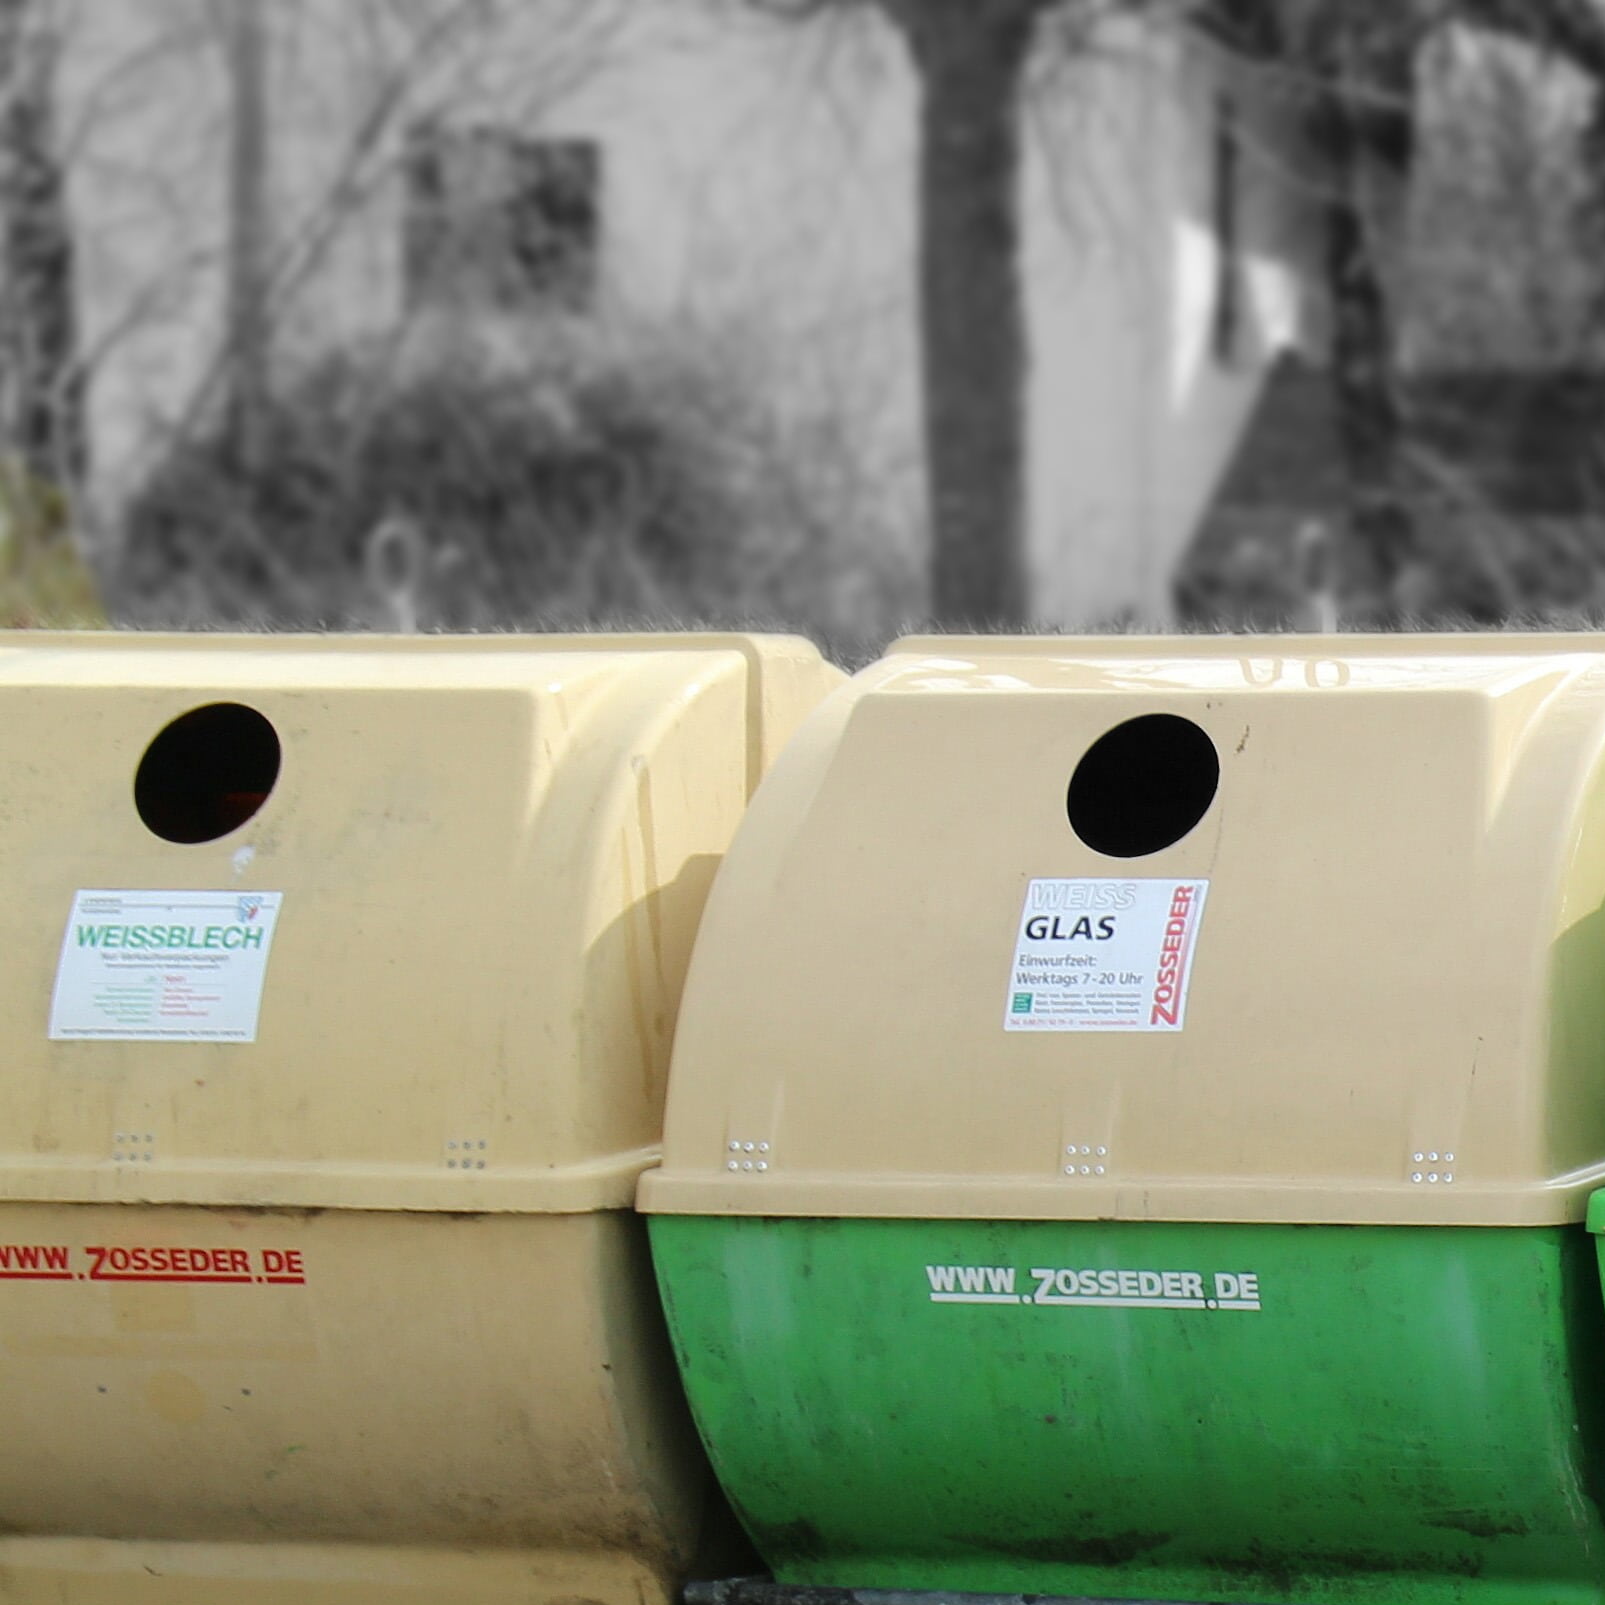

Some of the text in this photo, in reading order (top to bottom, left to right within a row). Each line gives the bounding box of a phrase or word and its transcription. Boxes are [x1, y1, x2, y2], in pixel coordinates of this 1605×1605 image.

[1031, 882, 1137, 911] WEISS
[77, 925, 264, 949] WEISSBLECH
[1025, 915, 1116, 941] GLAS
[1018, 953, 1097, 967] Einwurfzeit:
[1150, 885, 1194, 1026] ZOSSEDER
[1015, 972, 1078, 986] Werktags
[1119, 972, 1144, 985] Uhr
